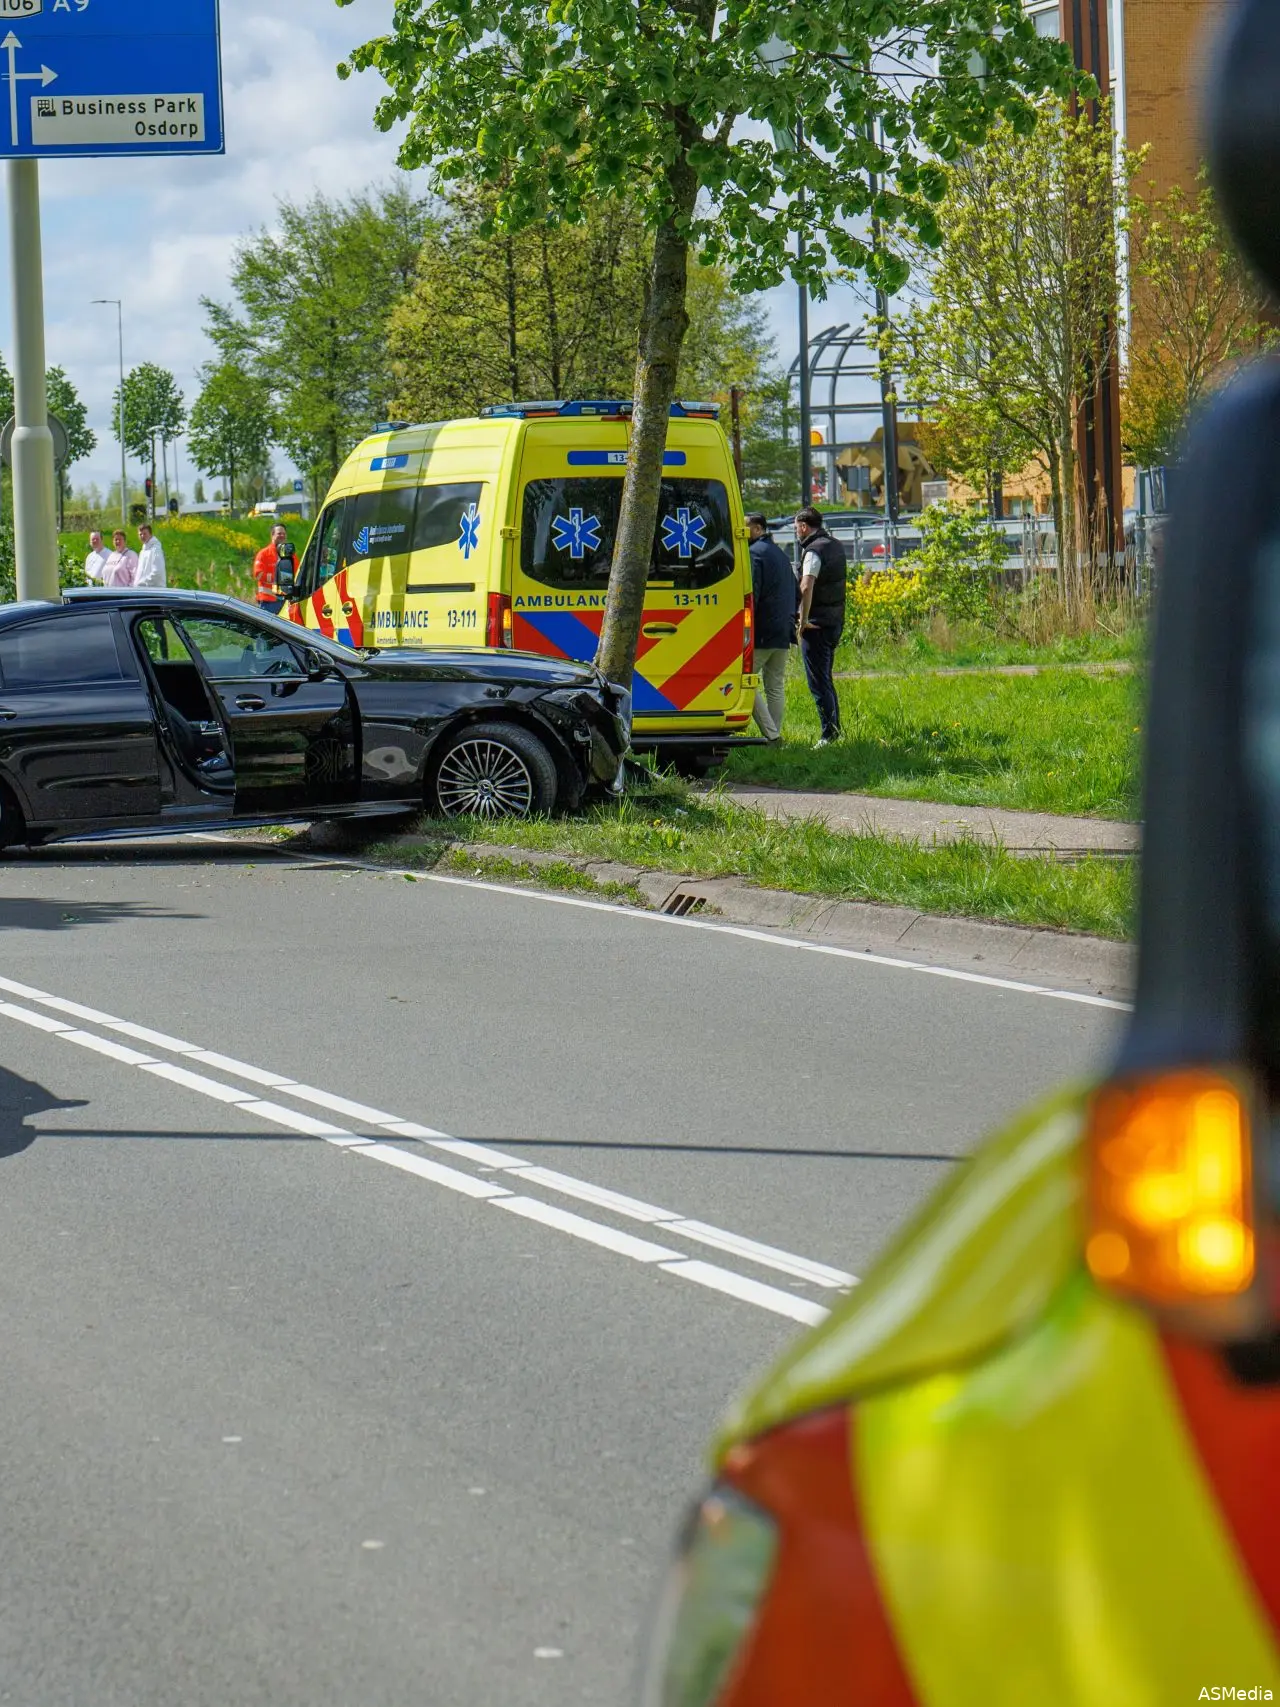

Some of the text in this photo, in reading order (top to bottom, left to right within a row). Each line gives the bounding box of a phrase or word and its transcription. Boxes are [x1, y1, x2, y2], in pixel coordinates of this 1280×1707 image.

[62, 98, 196, 115] Business Park
[135, 121, 198, 138] Osdorp
[514, 595, 718, 606] AMBULANC 13-111
[371, 610, 476, 628] AMBULANCE 13-111
